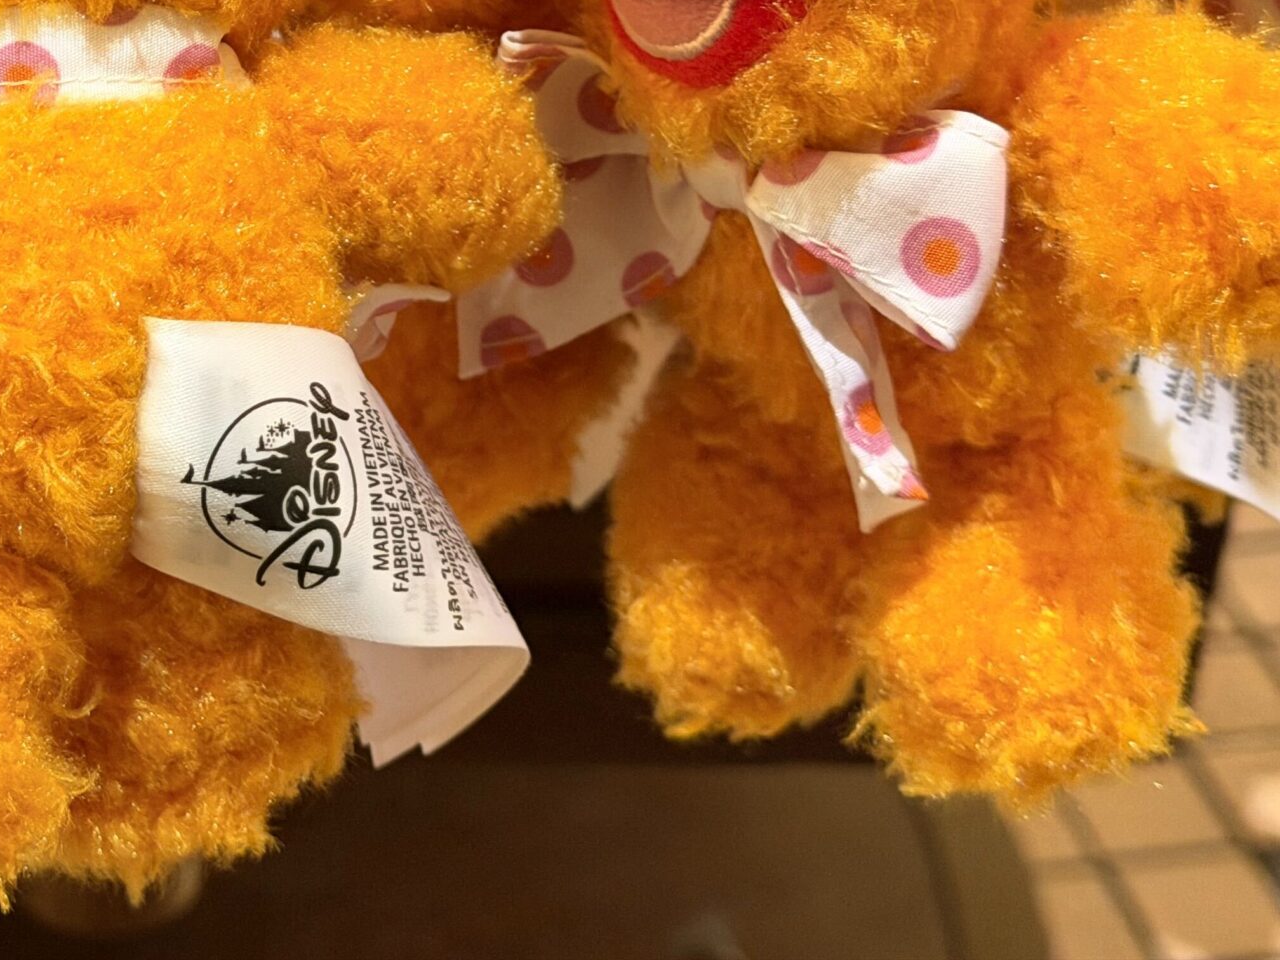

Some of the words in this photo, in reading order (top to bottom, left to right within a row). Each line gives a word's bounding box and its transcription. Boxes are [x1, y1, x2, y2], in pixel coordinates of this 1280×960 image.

[354, 408, 380, 488] VIETNAM
[360, 391, 388, 469] VIETNAM
[373, 408, 403, 484] VIETNAM
[371, 493, 385, 511] IN
[381, 473, 397, 498] AU
[397, 489, 411, 512] EN
[372, 516, 389, 570] MADE
[384, 502, 409, 592] FABRIQUÉ
[404, 516, 426, 577] HECHO
